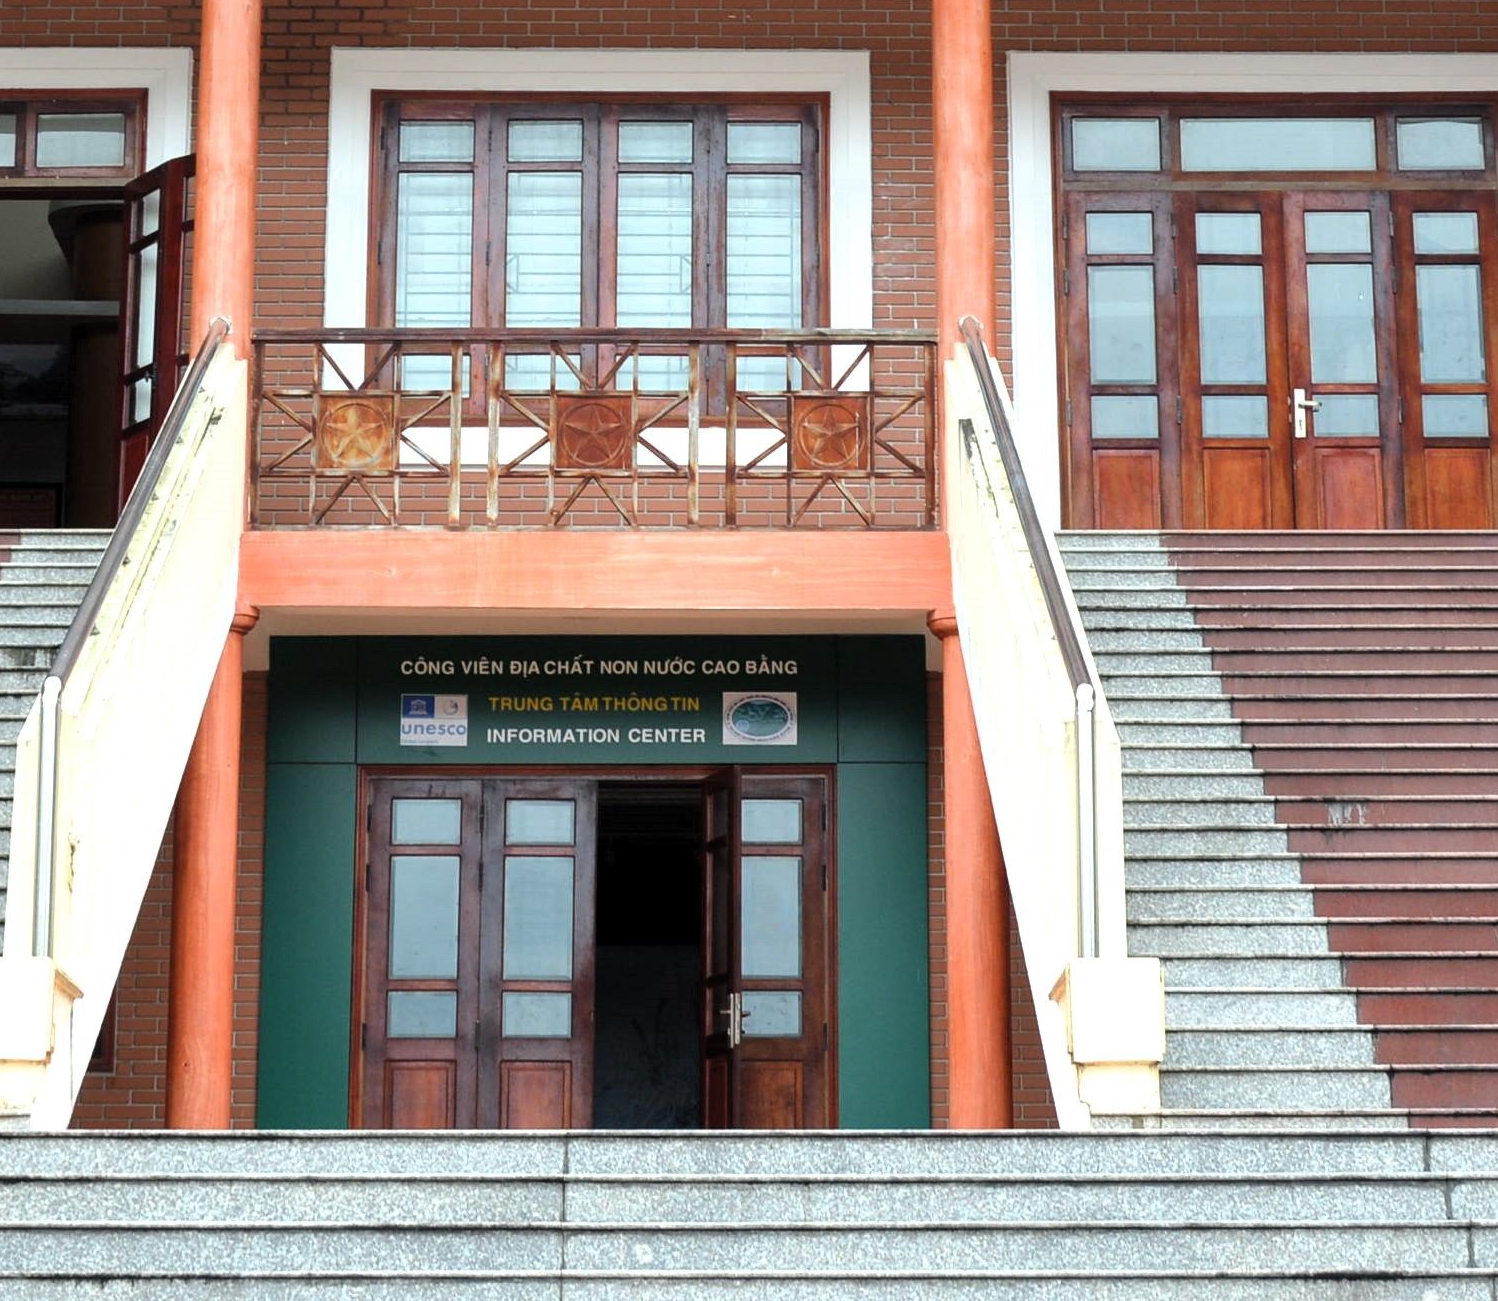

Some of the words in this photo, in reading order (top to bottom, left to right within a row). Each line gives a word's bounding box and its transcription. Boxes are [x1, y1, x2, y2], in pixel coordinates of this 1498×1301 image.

[401, 656, 455, 675] CÔNG
[461, 656, 503, 675] VIÊN
[510, 660, 540, 678] ĐỊA
[544, 654, 595, 675] CHẤT
[600, 660, 638, 675] NON
[643, 656, 696, 675] NƯỚC
[701, 660, 740, 675] CAO
[745, 654, 798, 675] BẰNG
[488, 697, 553, 711] TRUNG
[559, 692, 598, 711] TÂM
[602, 692, 667, 711] THÔNG
[671, 697, 700, 711] TIN
[401, 723, 467, 735] unesco
[487, 728, 620, 743] INFORMATION
[628, 728, 706, 743] CENTER
